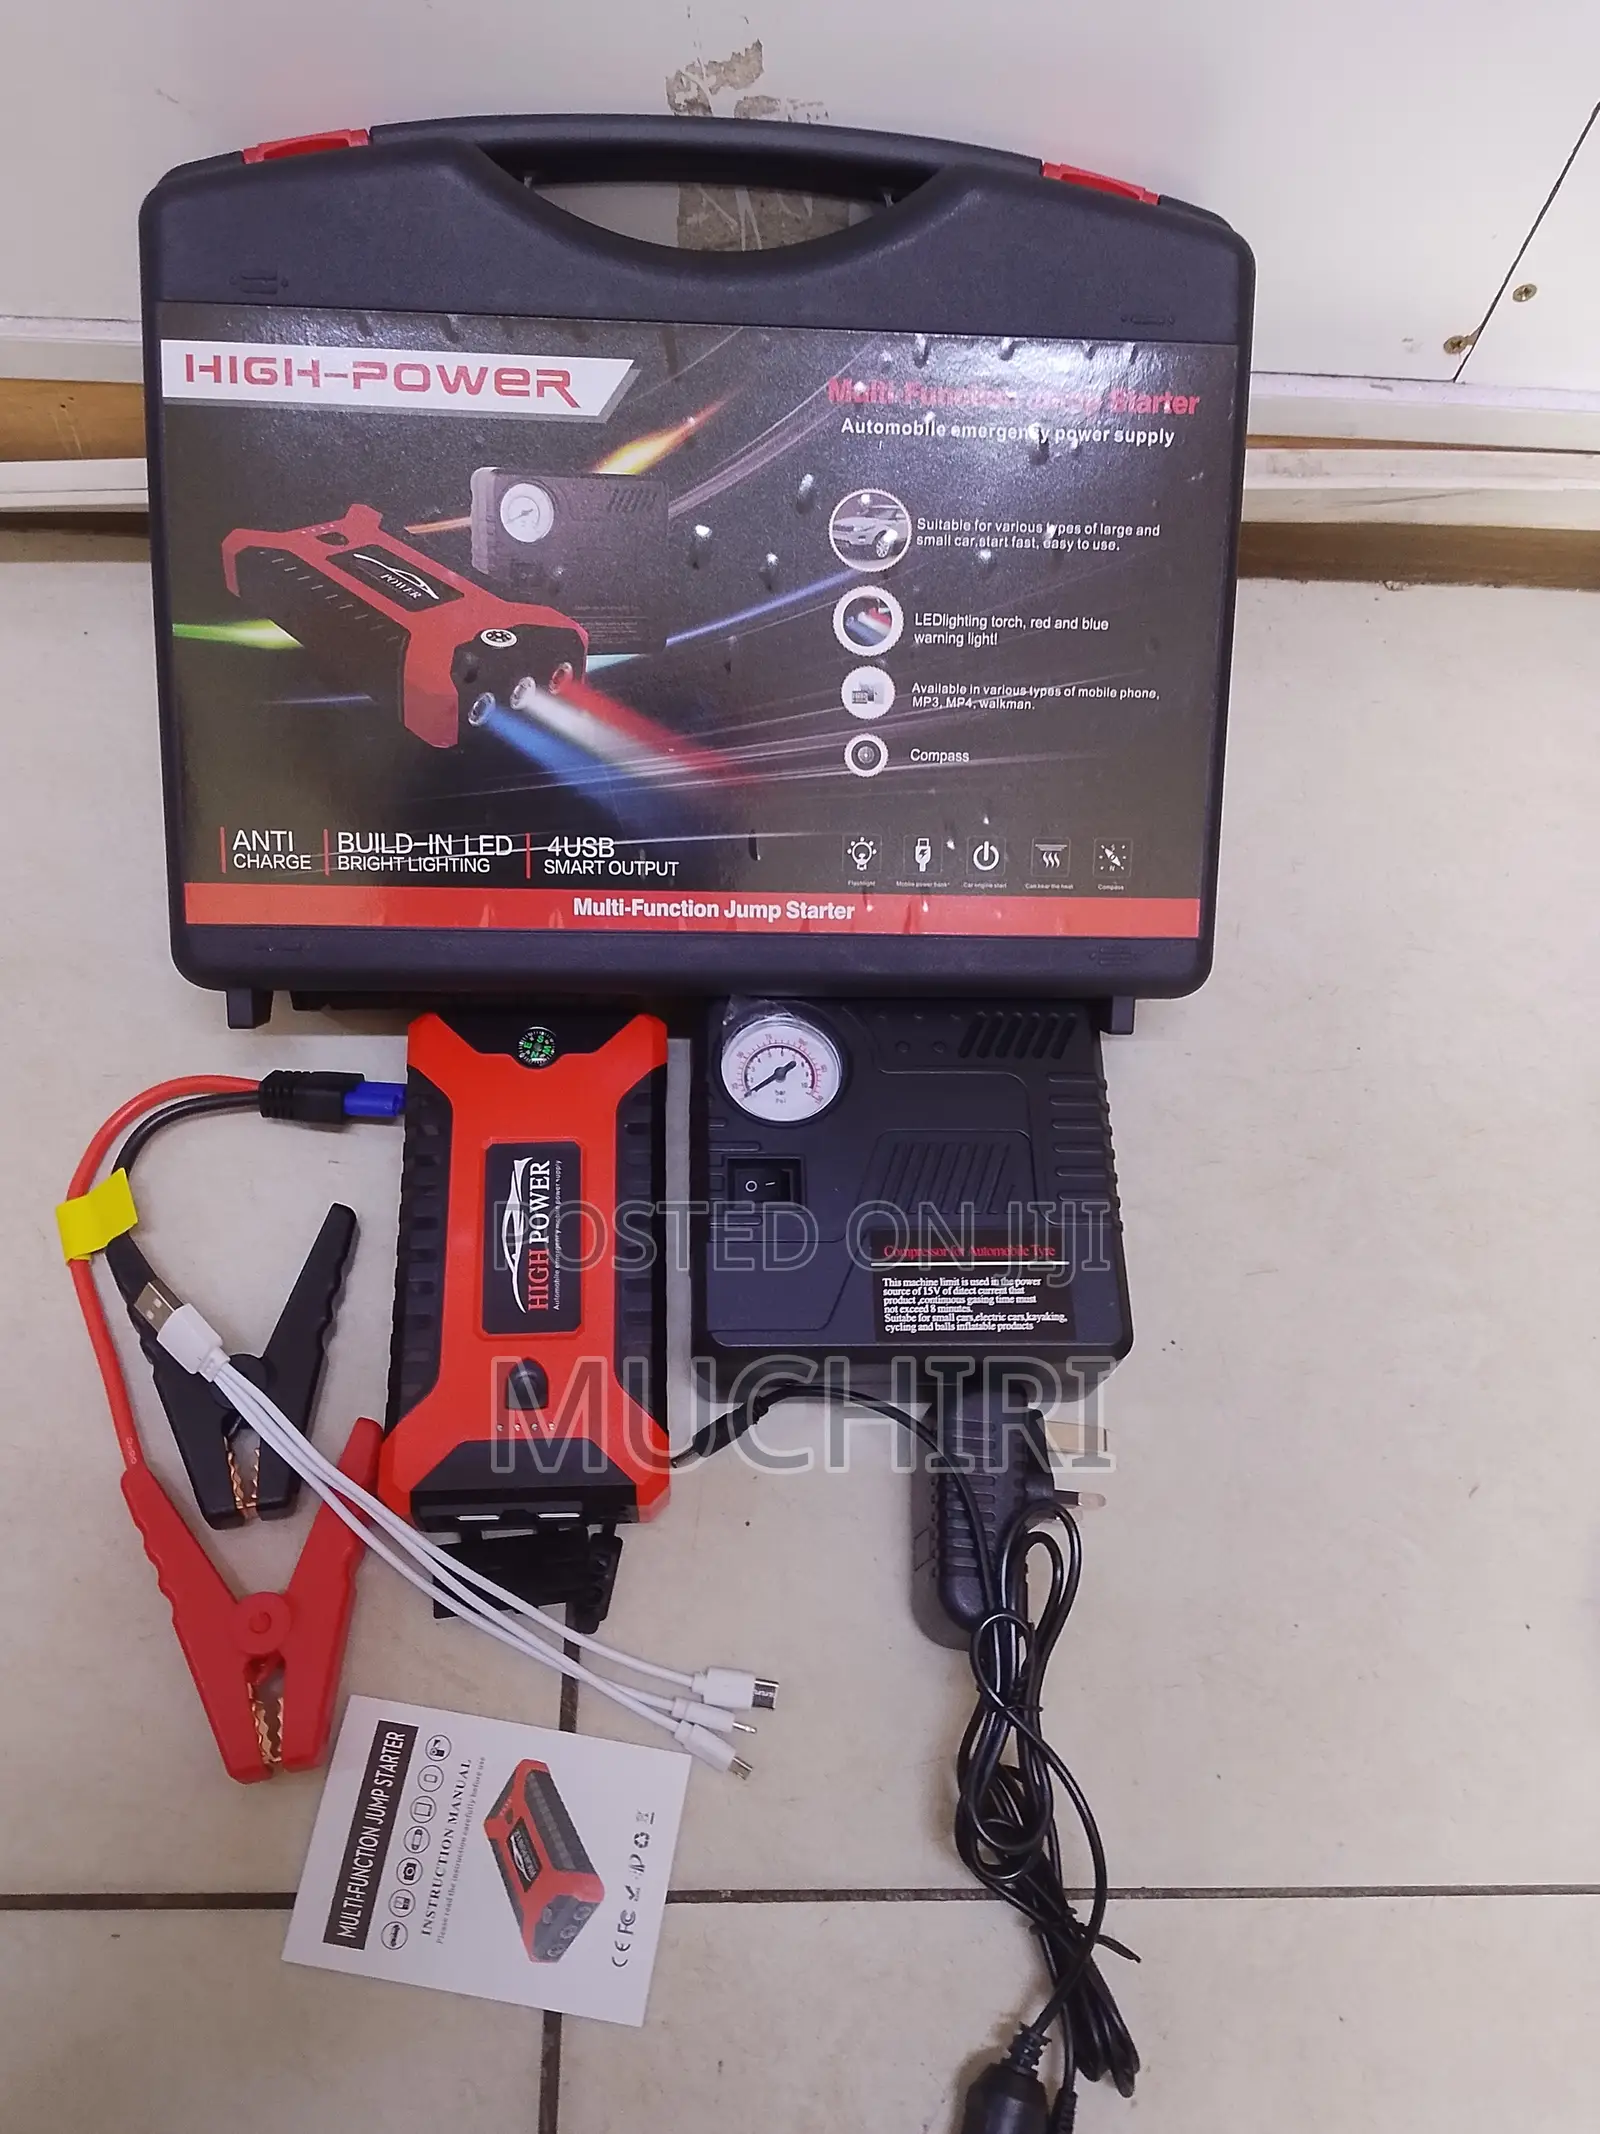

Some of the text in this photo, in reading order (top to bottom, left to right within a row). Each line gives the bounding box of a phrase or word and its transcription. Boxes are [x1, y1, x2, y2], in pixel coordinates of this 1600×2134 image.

[841, 418, 1175, 447] Automobile emergency power supply
[917, 517, 971, 532] Suitable
[974, 518, 992, 533] for
[995, 519, 1043, 534] various
[1084, 521, 1098, 535] of
[1101, 521, 1132, 538] large
[1136, 523, 1160, 537] and
[916, 535, 951, 547] small
[1043, 539, 1074, 552] easy
[1077, 539, 1089, 551] to
[991, 615, 1026, 630] torch,
[1030, 616, 1051, 629] red
[1054, 617, 1078, 630] and
[1082, 617, 1109, 631] blue
[914, 632, 998, 648] warning light!
[912, 682, 1160, 700] Available in various types of mobile phone,
[910, 748, 970, 763] Compass
[232, 829, 294, 852] ANTI
[337, 831, 513, 856] BUILD-IN LED
[547, 836, 615, 858] 4USB
[233, 853, 312, 870] CHARGE
[338, 855, 490, 873] BRIGHT LIGHTING
[544, 858, 680, 877] SMART OUTPUT
[573, 897, 856, 923] Multi-Function Jump Starter
[528, 1160, 551, 1312] HIGH POWER
[969, 1245, 1029, 1257] Automobile
[1030, 1244, 1056, 1260] Tyre
[553, 1271, 562, 1311] Automobile
[882, 1277, 1042, 1288] This machine limit is used in the power
[882, 1288, 911, 1296] source
[912, 1286, 922, 1296] of
[923, 1286, 941, 1296] 15V
[942, 1286, 952, 1295] of
[977, 1286, 1007, 1295] current
[1008, 1286, 1025, 1295] that
[883, 1296, 916, 1306] product
[995, 1295, 1015, 1304] time
[1015, 1296, 1037, 1304] must
[884, 1305, 898, 1314] not
[899, 1305, 929, 1314] exceed
[918, 1313, 931, 1322] for
[932, 1313, 955, 1322] small
[885, 1321, 1034, 1334] cycling and balls inflatable products
[478, 1757, 486, 1770] use
[470, 1772, 482, 1798] before
[463, 1799, 476, 1836] carefully
[336, 1731, 406, 1939] MULTI-FUNCTION JUMP STARTER
[421, 1760, 472, 1936] INSTRUCTION MANUAL
[448, 1883, 456, 1897] the
[444, 1898, 453, 1916] read
[436, 1917, 449, 1944] Please
